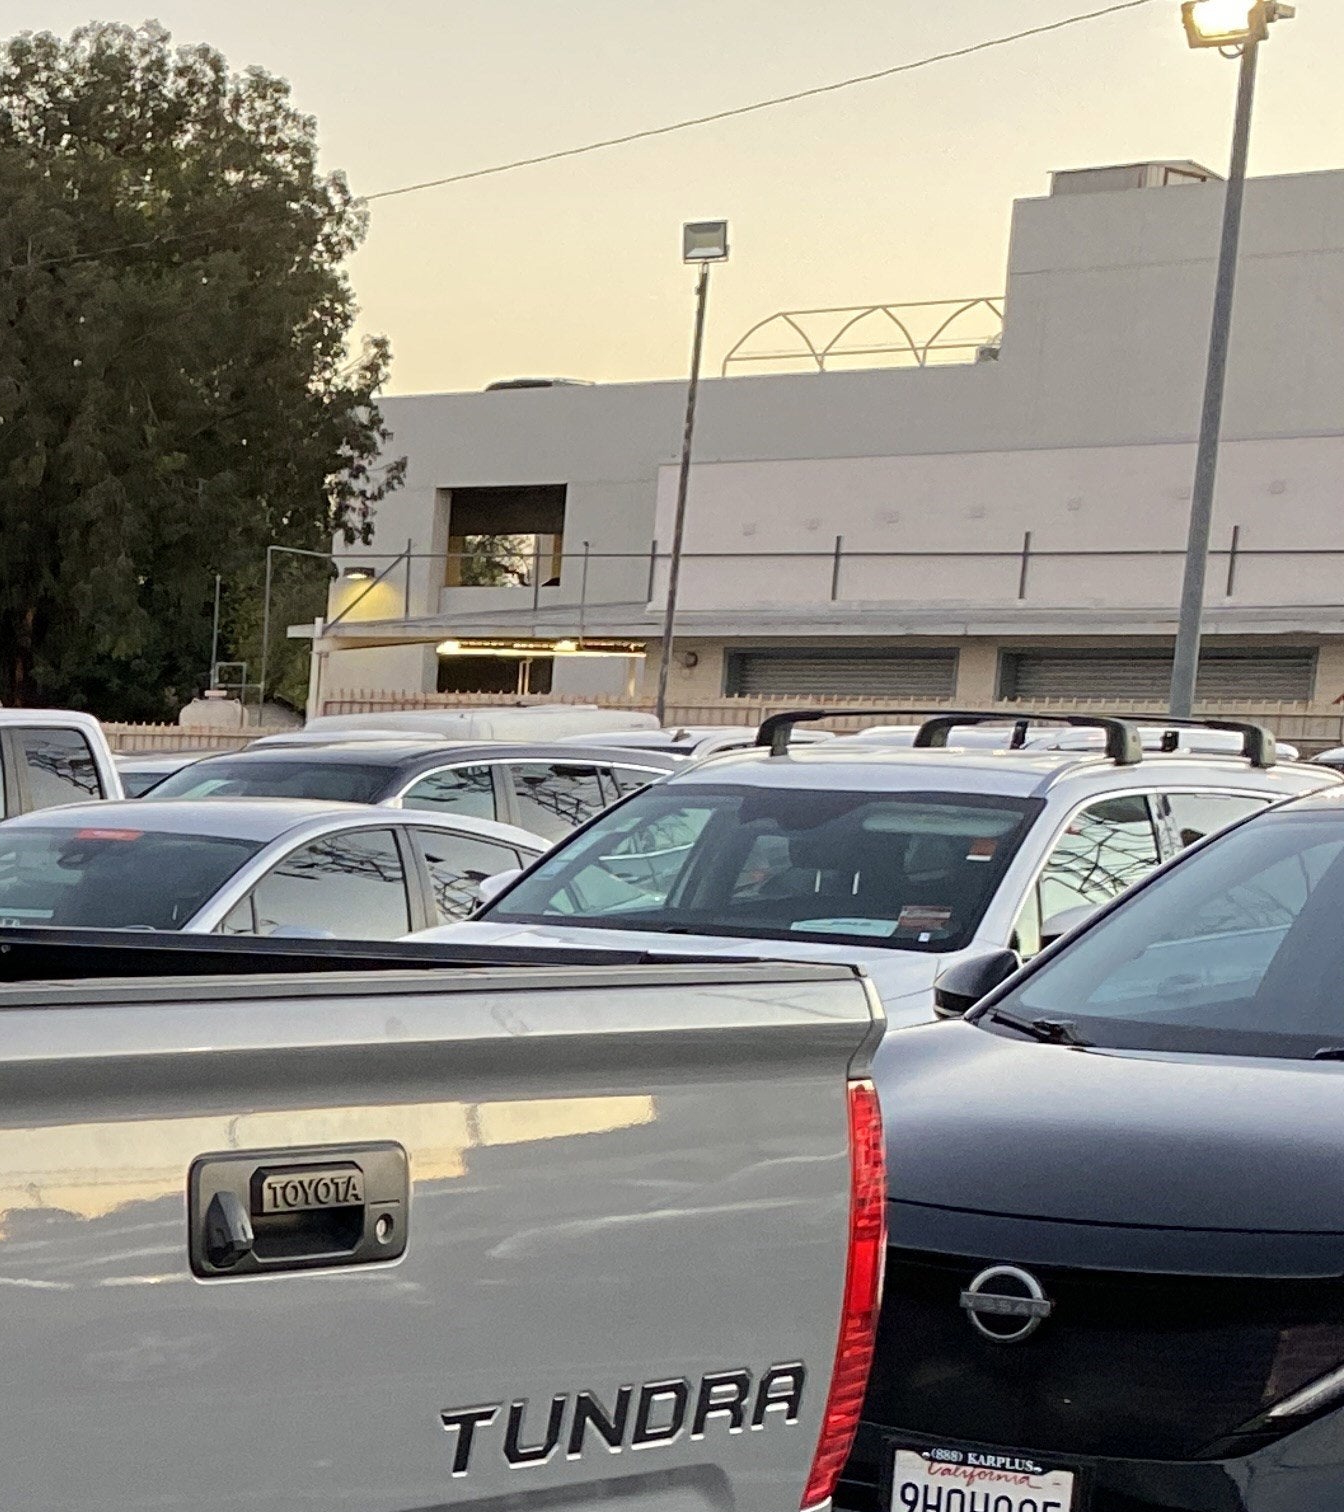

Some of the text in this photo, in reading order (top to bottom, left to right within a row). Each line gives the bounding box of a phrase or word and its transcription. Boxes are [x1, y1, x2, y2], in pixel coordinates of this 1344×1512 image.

[267, 1175, 362, 1209] TOYOTA
[439, 1359, 806, 1478] TUNDRA
[927, 1460, 1043, 1489] California
[931, 1448, 1035, 1472] (888) KARPLUS
